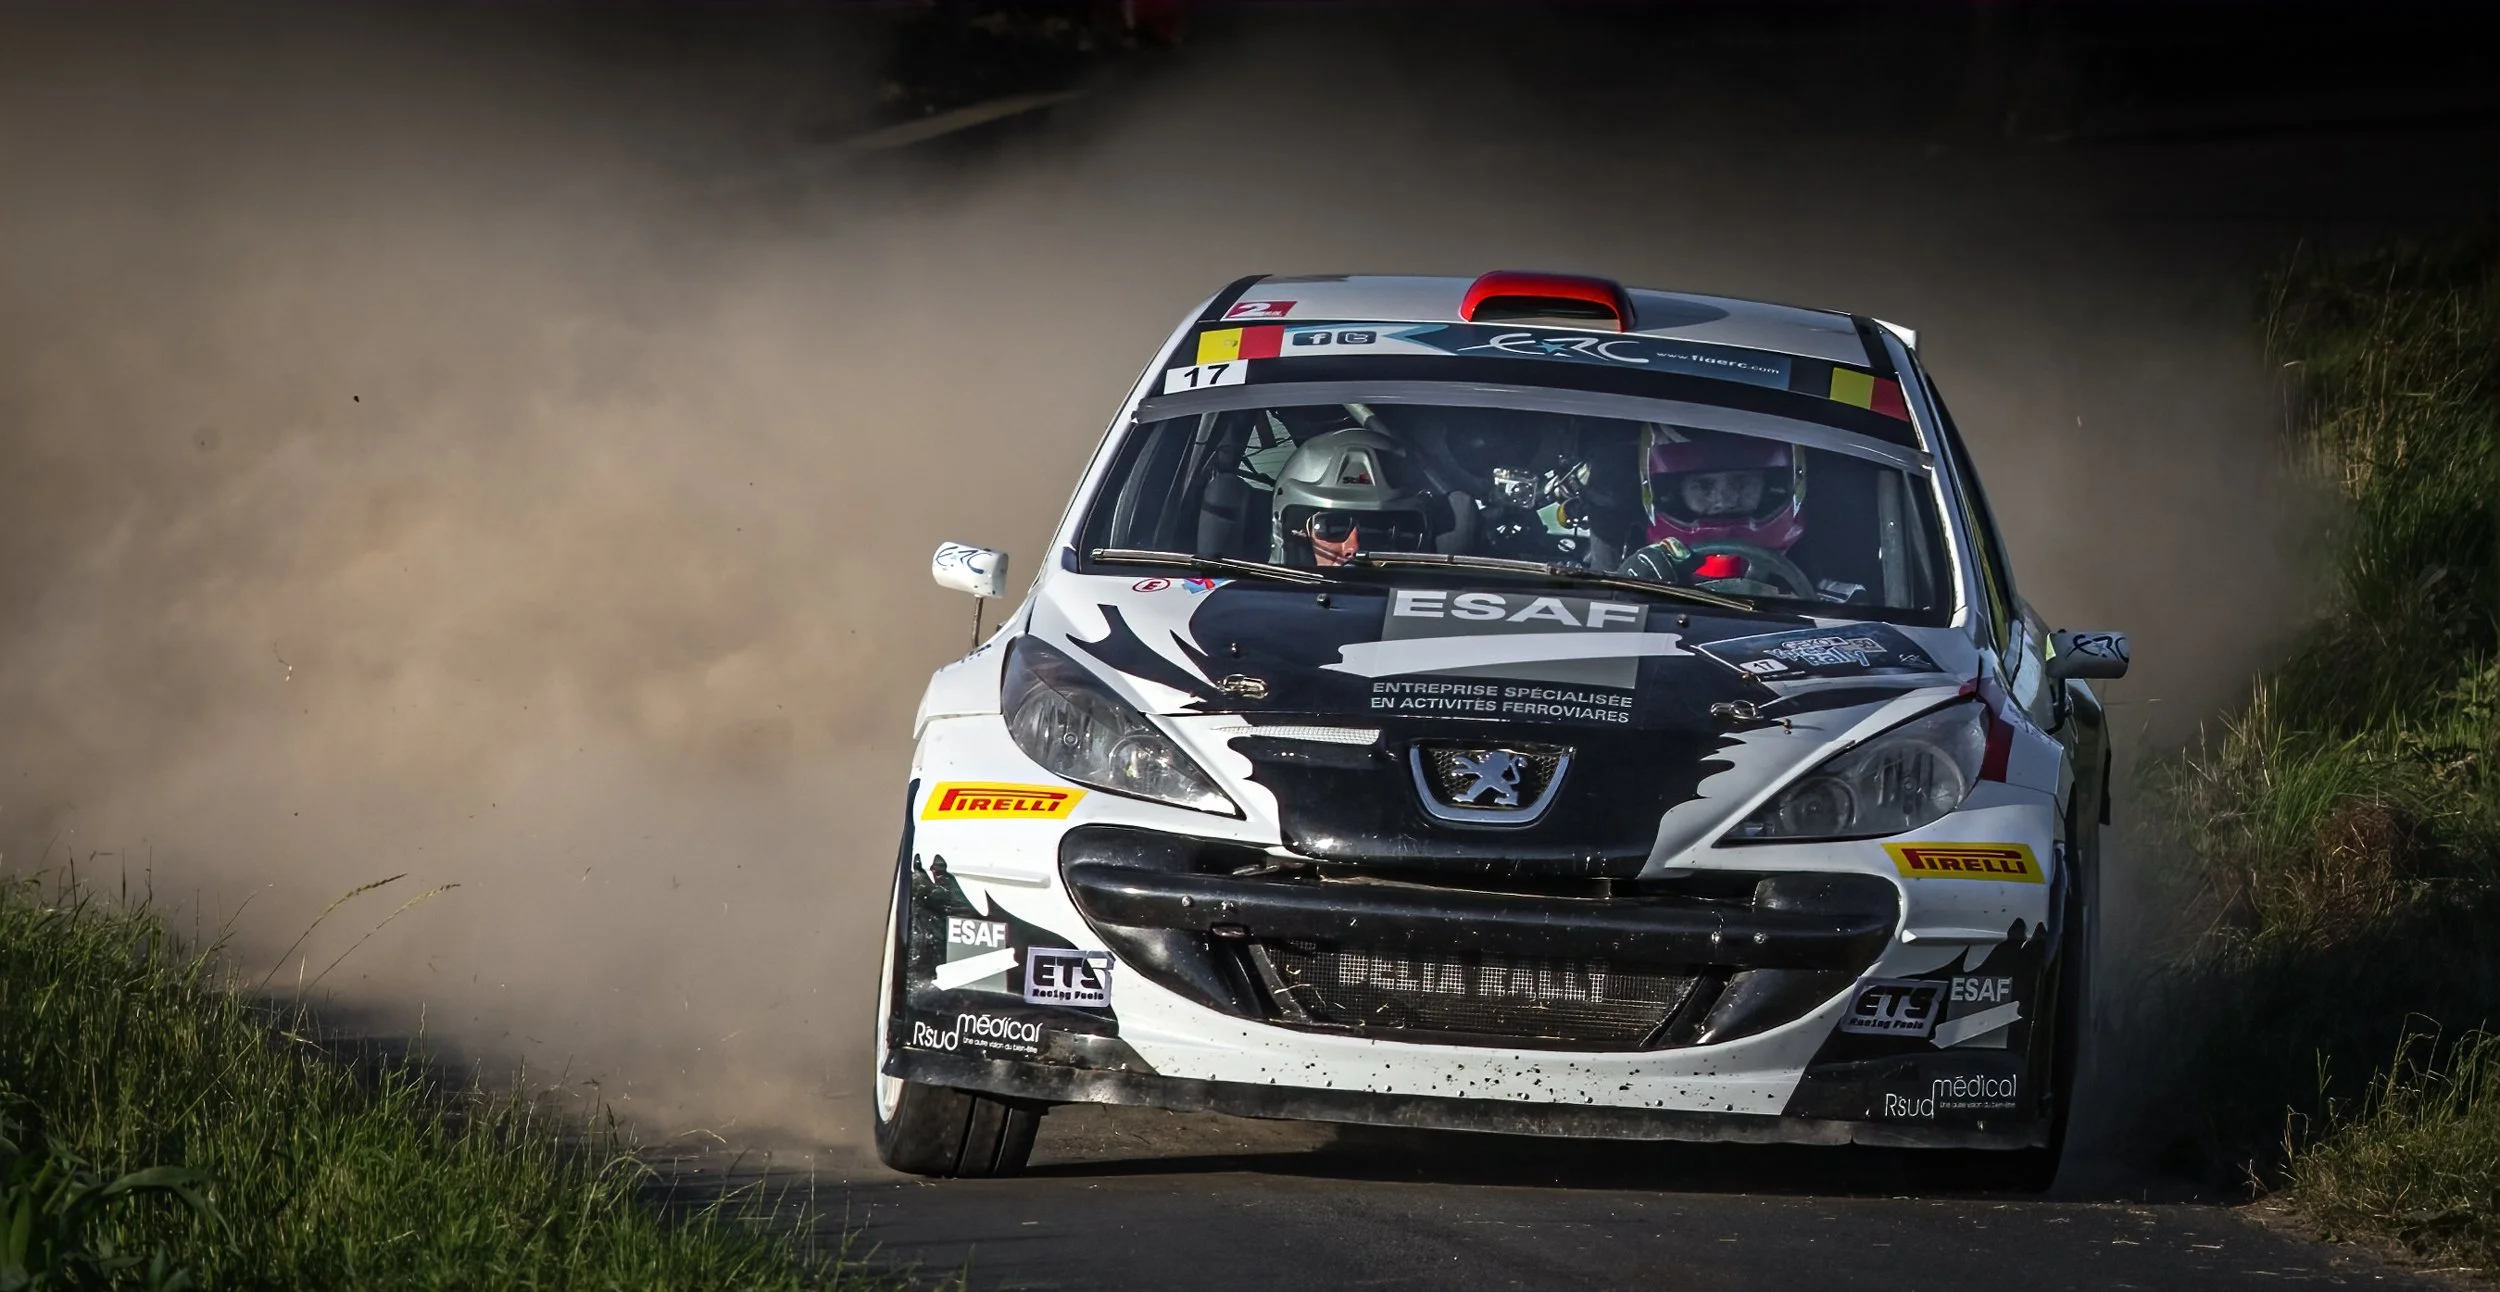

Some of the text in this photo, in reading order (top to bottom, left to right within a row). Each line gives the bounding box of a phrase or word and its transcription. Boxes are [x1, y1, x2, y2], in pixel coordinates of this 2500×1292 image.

[1183, 364, 1230, 388] 17
[1142, 581, 1162, 590] E
[1393, 590, 1639, 628] ESAF
[1753, 661, 1775, 671] 17
[1372, 682, 1632, 708] ENTREPRISE SPÉCIALISÉE
[1371, 697, 1629, 723] EN ACTIVITÉS FERROVIARES
[938, 788, 1068, 812] PIRELLI
[1901, 848, 2028, 875] PIRELLI
[948, 923, 1006, 948] ESAF
[1033, 953, 1107, 989] ETS
[1032, 988, 1071, 1000] Racing
[1951, 977, 2011, 1002] ESAF
[1932, 1074, 2017, 1097] médical
